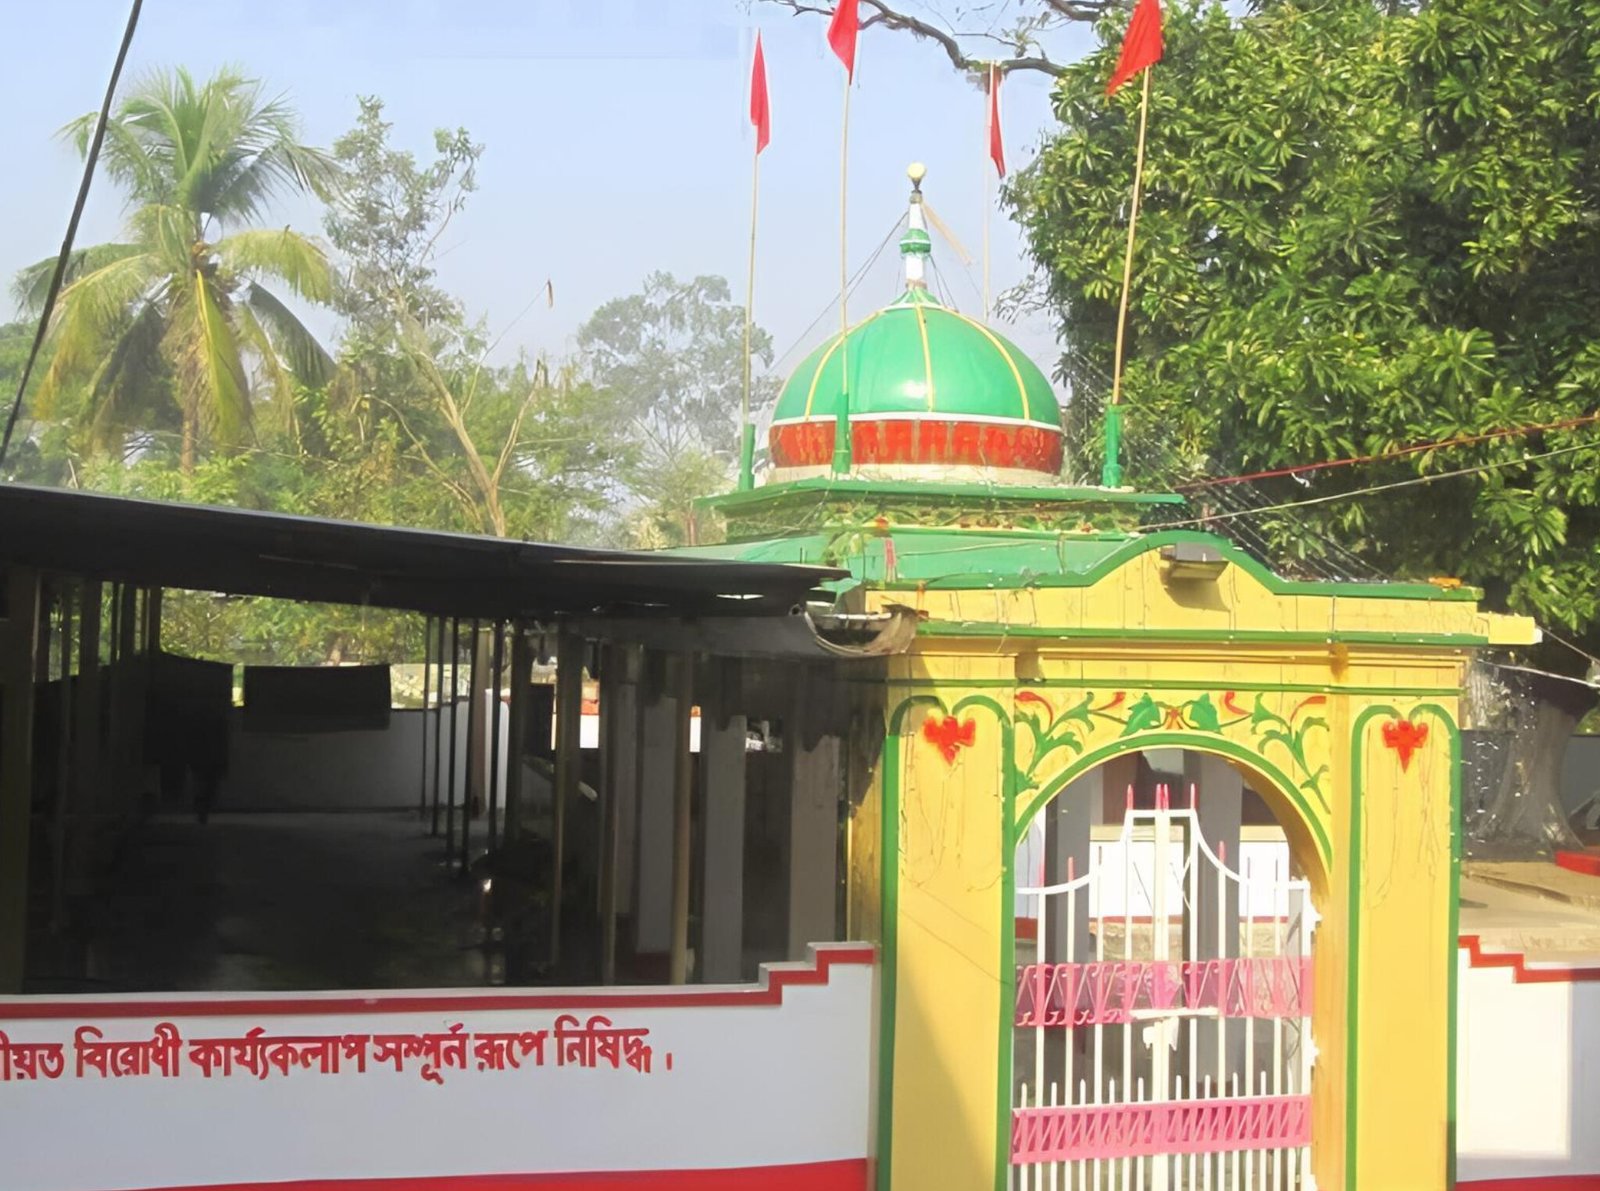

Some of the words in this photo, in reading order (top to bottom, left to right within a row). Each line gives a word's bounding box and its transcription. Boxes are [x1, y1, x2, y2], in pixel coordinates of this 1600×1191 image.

[0, 1030, 65, 1081] ীয়ত
[74, 1022, 183, 1077] বিরোধী
[554, 1014, 652, 1073] নিষিদ্ধ
